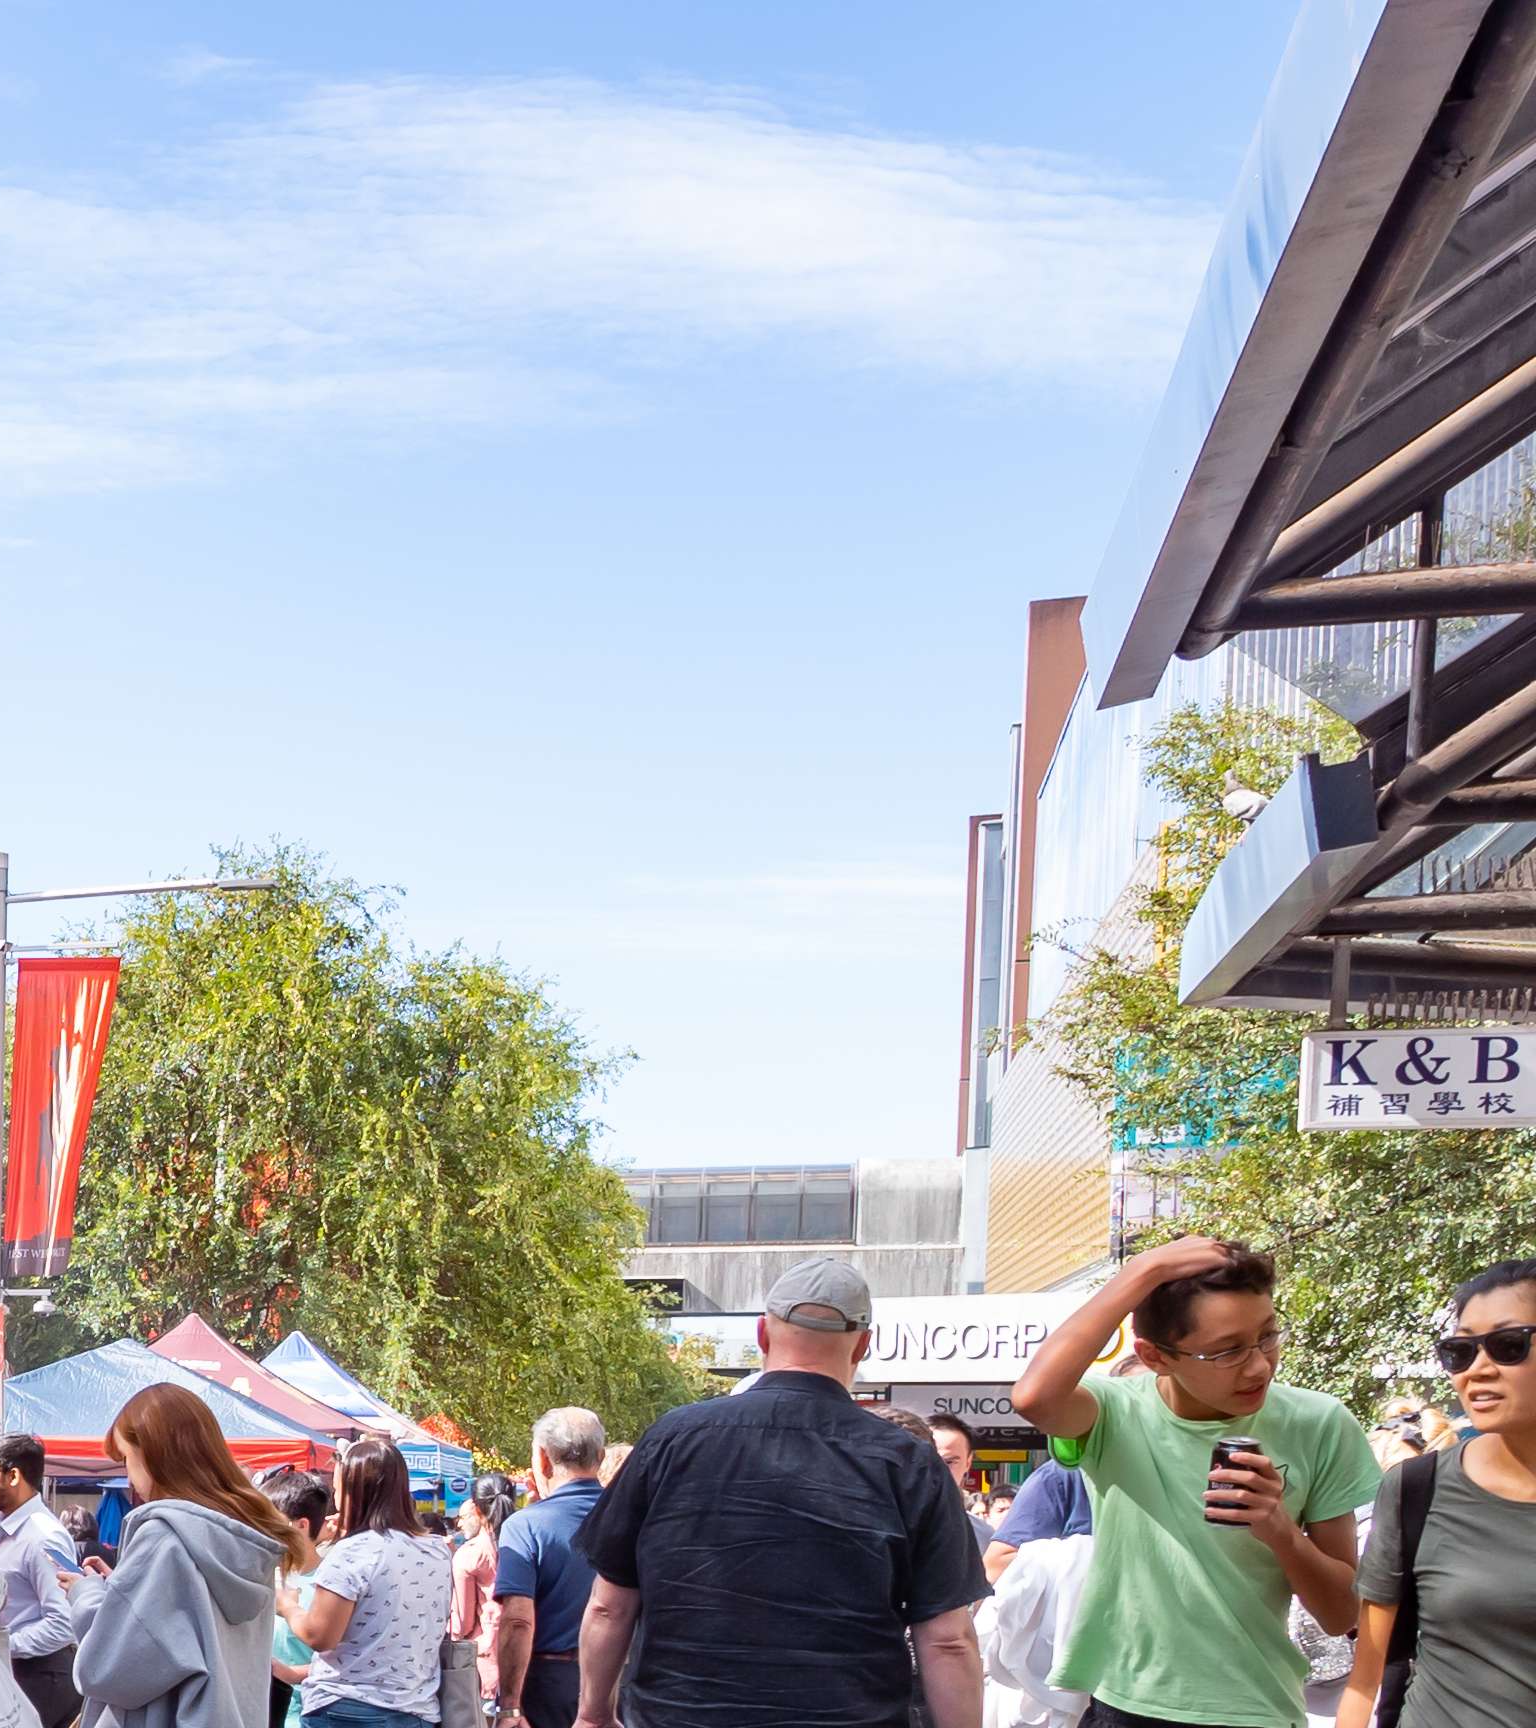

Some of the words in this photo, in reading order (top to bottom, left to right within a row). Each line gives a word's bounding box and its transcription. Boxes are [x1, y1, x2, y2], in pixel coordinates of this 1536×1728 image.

[1323, 1039, 1378, 1086] K
[1395, 1036, 1450, 1085] &
[1468, 1036, 1520, 1084] B
[1326, 1091, 1517, 1117] 補習學校
[933, 1397, 1018, 1415] SUNCO
